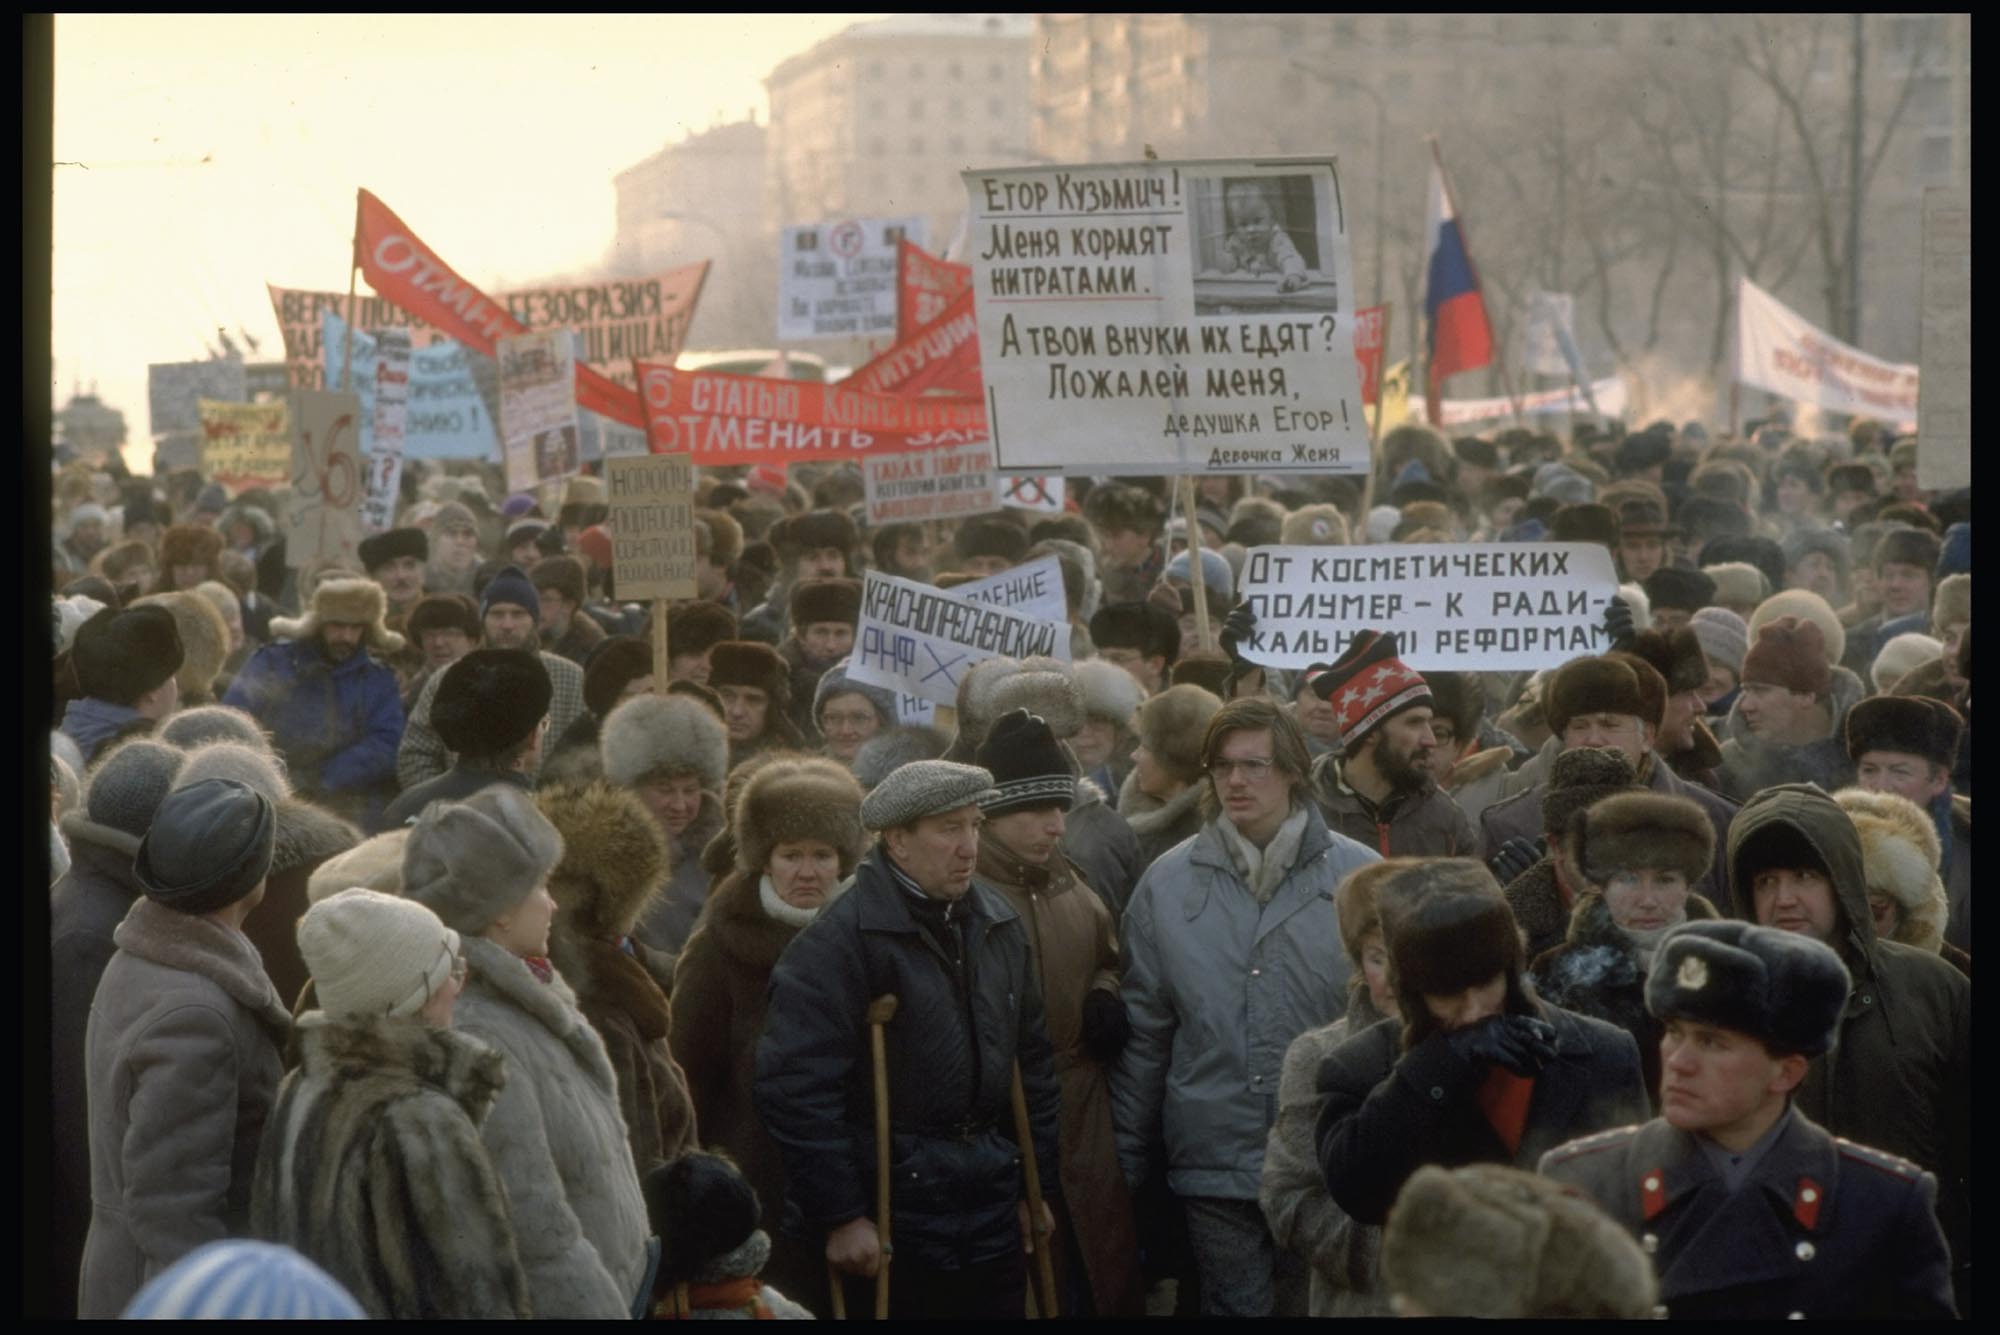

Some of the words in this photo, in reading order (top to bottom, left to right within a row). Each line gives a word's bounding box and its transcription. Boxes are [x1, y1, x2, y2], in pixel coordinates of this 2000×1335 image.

[1000, 313, 1021, 358] А
[643, 369, 673, 409] 6
[691, 375, 799, 423] СТАТЬЮ
[652, 414, 874, 451] ОТМЕНИТЬ
[1311, 550, 1570, 584] КОСМЕТИЧЕСКИХ
[1249, 592, 1403, 622] ПОЛУМЕР
[1445, 591, 1464, 618] К
[1435, 623, 1613, 654] РЕФОРМАМ
